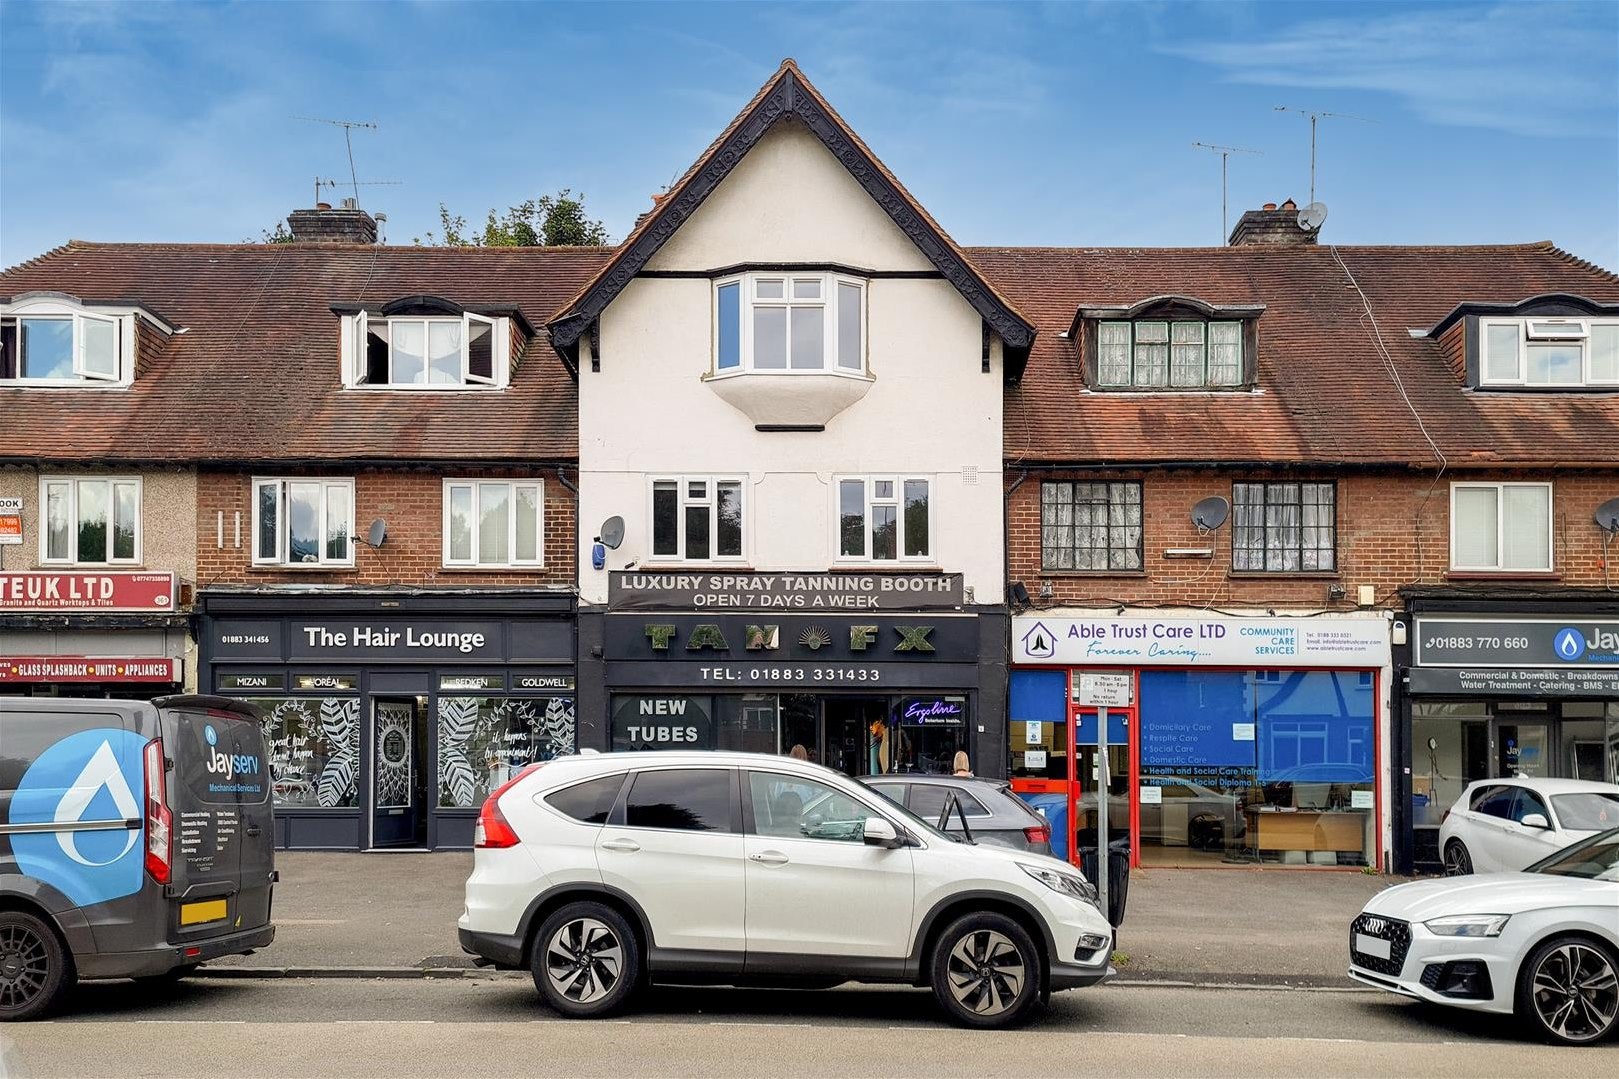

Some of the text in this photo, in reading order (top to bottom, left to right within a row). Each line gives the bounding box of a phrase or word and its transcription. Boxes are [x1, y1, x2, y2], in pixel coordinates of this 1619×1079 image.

[70, 577, 114, 599] LTD
[622, 576, 951, 592] LUXURY SPRAY TANNING BOOTH
[60, 600, 90, 608] Worktops
[694, 594, 880, 608] OPEN 7 DAYS A WEEK
[1068, 624, 1226, 638] Able Trust Care LTD
[1240, 628, 1294, 636] COMMUNITY
[222, 635, 270, 644] 01883 341456
[304, 627, 485, 652] The Hair Lounge
[645, 624, 936, 651] TAN FX
[1436, 638, 1528, 648] 01883 770 660
[1086, 640, 1141, 657] Forever
[1255, 646, 1295, 654] SERVICES
[18, 664, 167, 676] GLASS SPLASHBACK UNITS APPLIANCES
[700, 668, 880, 681] TEL: 01883 331433
[1460, 671, 1509, 679] Commercial
[1520, 672, 1559, 680] Domestic
[1567, 672, 1618, 680] Breakdowns
[237, 678, 267, 686] MIZANI
[455, 678, 488, 686] REDKEN
[522, 678, 567, 687] GOLDWELL
[1461, 681, 1485, 689] Water
[1488, 681, 1531, 689] Treatment
[1540, 682, 1575, 690] Catering
[640, 700, 686, 715] NEW
[627, 726, 698, 742] TUBES
[206, 746, 258, 780] Jayserv
[1149, 756, 1207, 764] Domestic Care
[1149, 767, 1174, 775] Health
[1176, 767, 1192, 775] and
[1194, 767, 1217, 775] Social
[1240, 768, 1270, 776] Training
[1219, 779, 1252, 787] Diploma
[237, 784, 254, 792] Services
